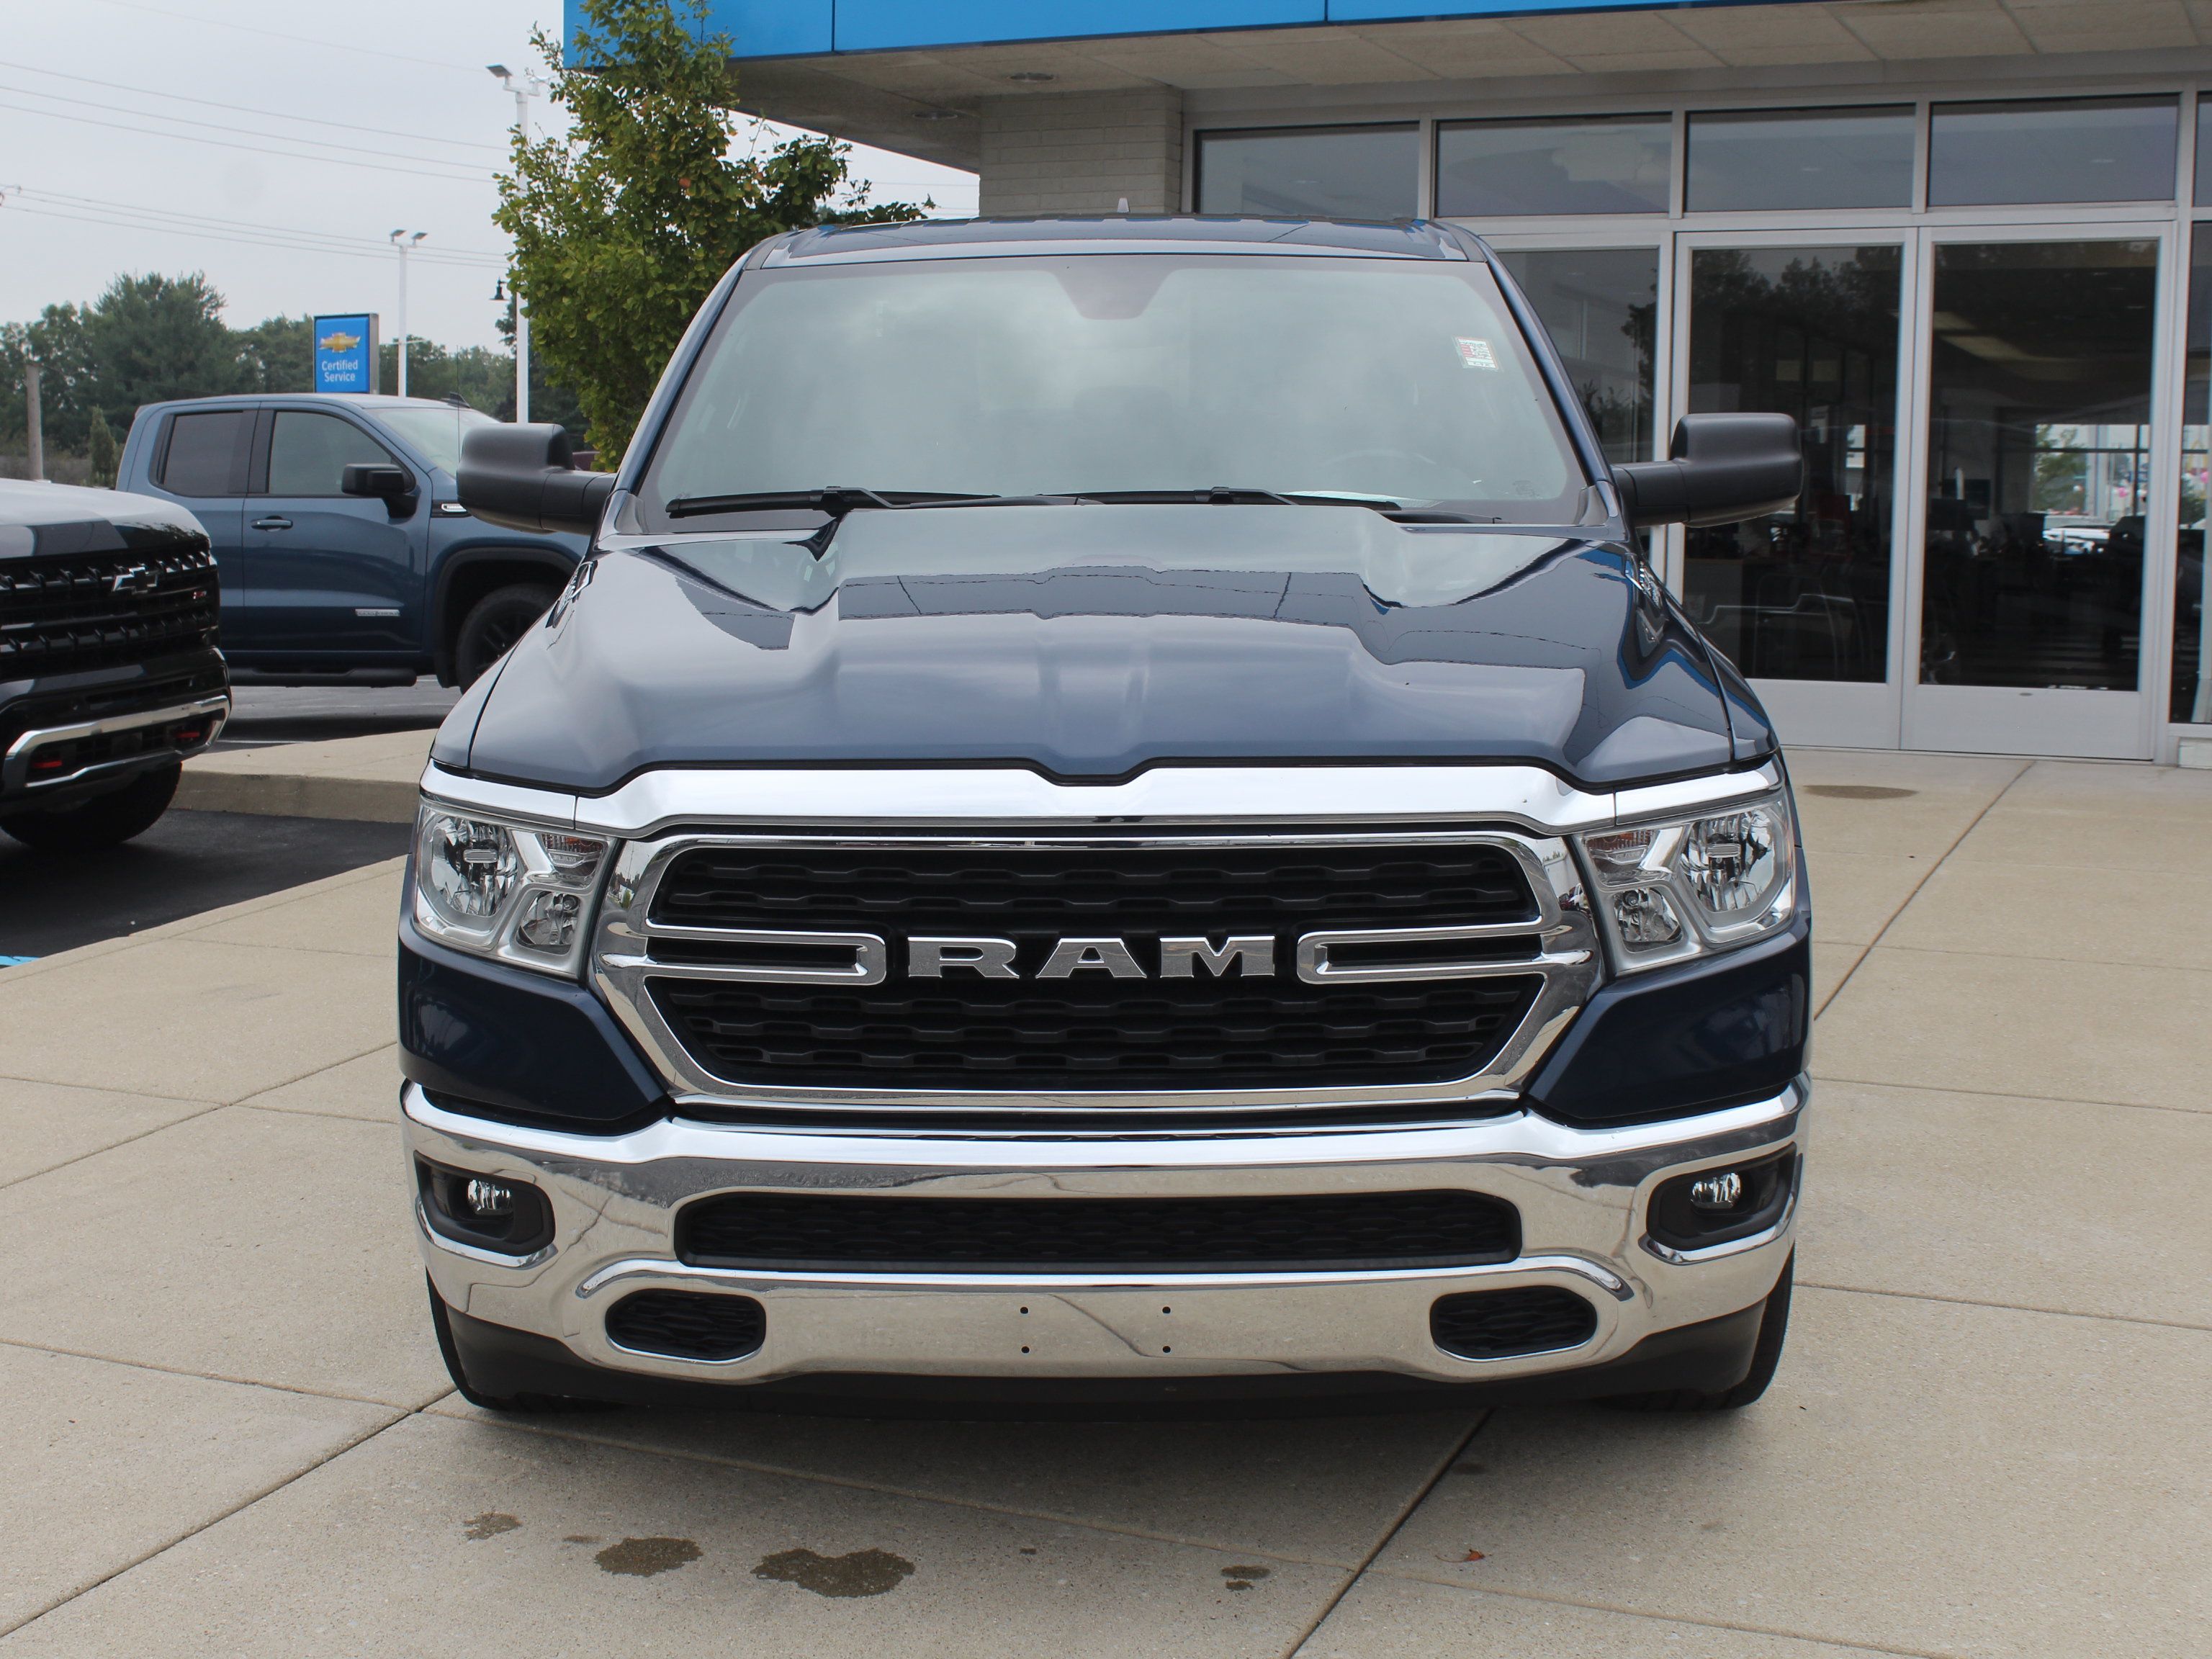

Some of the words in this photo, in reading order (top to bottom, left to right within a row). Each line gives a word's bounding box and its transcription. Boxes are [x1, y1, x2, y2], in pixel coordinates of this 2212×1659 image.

[322, 359, 358, 371] Certified
[325, 372, 356, 382] Service
[907, 935, 1275, 979] RAM
